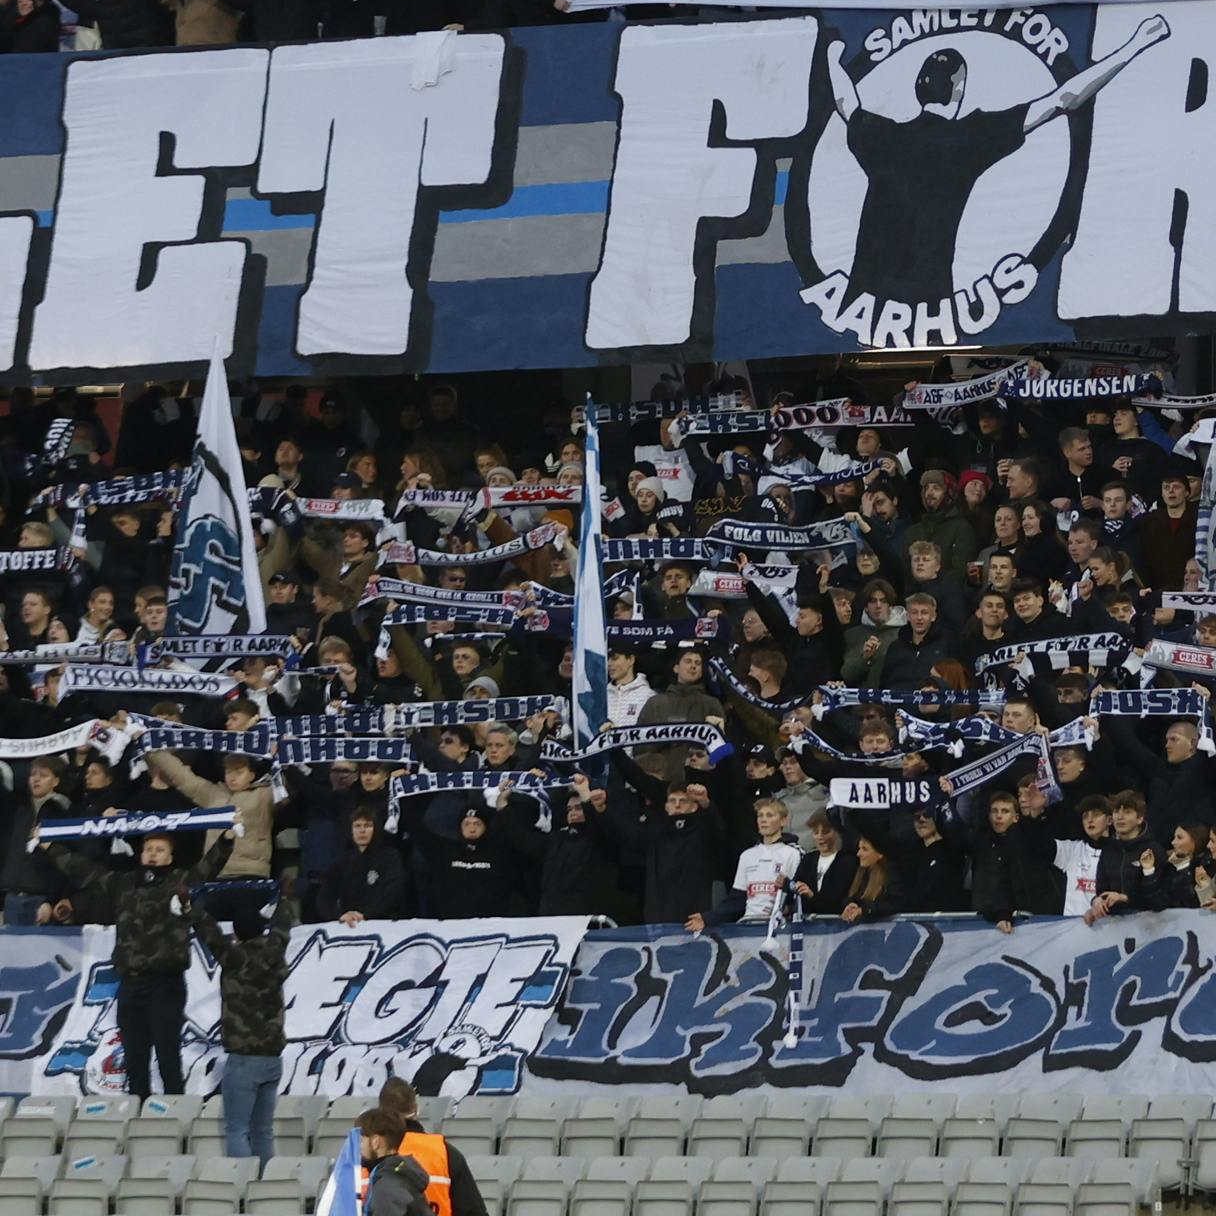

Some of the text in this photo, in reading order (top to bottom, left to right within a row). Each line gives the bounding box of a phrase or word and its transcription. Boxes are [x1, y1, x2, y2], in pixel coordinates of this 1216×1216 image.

[864, 7, 1070, 66] SAMLET FOR
[0, 34, 506, 372] ET
[800, 253, 1040, 349] AARHUS
[923, 388, 944, 404] AGF
[954, 378, 1001, 401] AARHUS
[1018, 374, 1136, 398] JØRGENSEN
[765, 530, 810, 544] VILJEN
[716, 578, 745, 592] CERES
[631, 625, 652, 635] SOM
[1173, 649, 1213, 667] CERES
[645, 725, 719, 747] AARHUS
[849, 780, 931, 805] AARHUS
[750, 884, 777, 896] CERES
